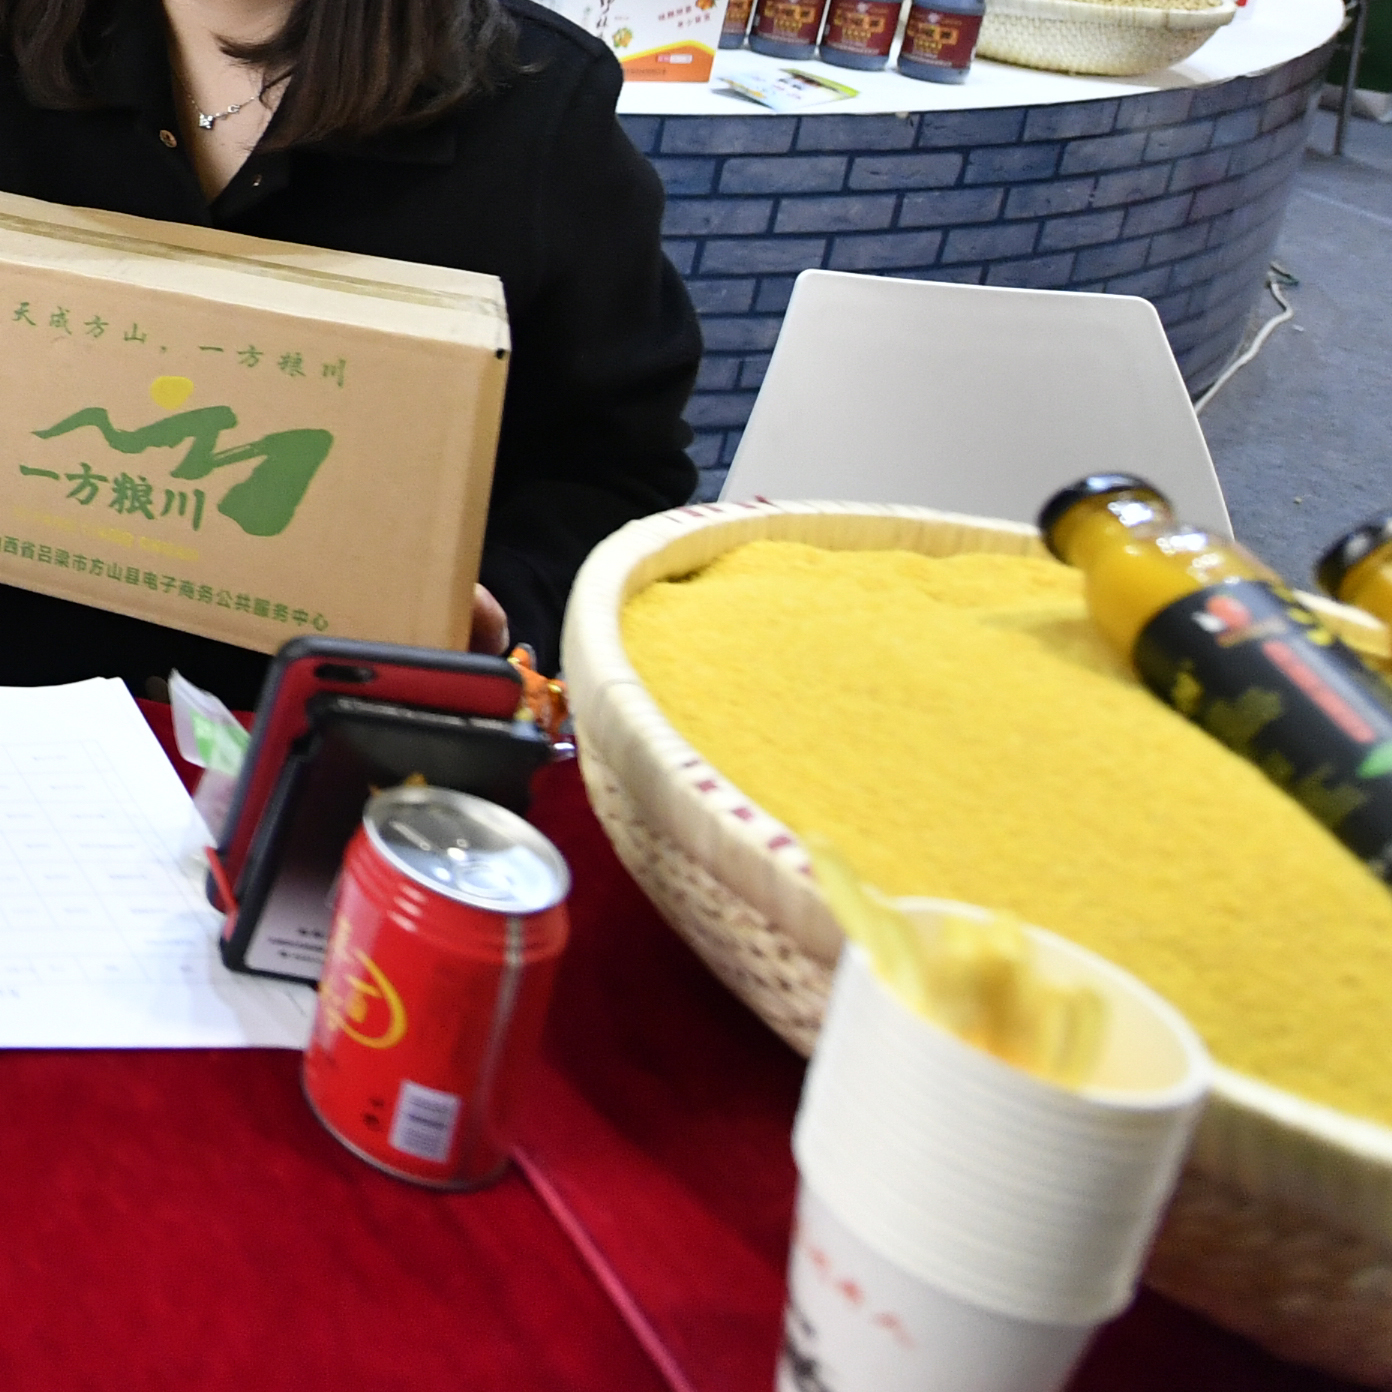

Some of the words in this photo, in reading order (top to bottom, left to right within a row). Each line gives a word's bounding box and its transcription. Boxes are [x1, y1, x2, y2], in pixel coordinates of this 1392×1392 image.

[13, 300, 348, 388] 天成方山，一方粮川
[18, 460, 206, 532] 一方粮川
